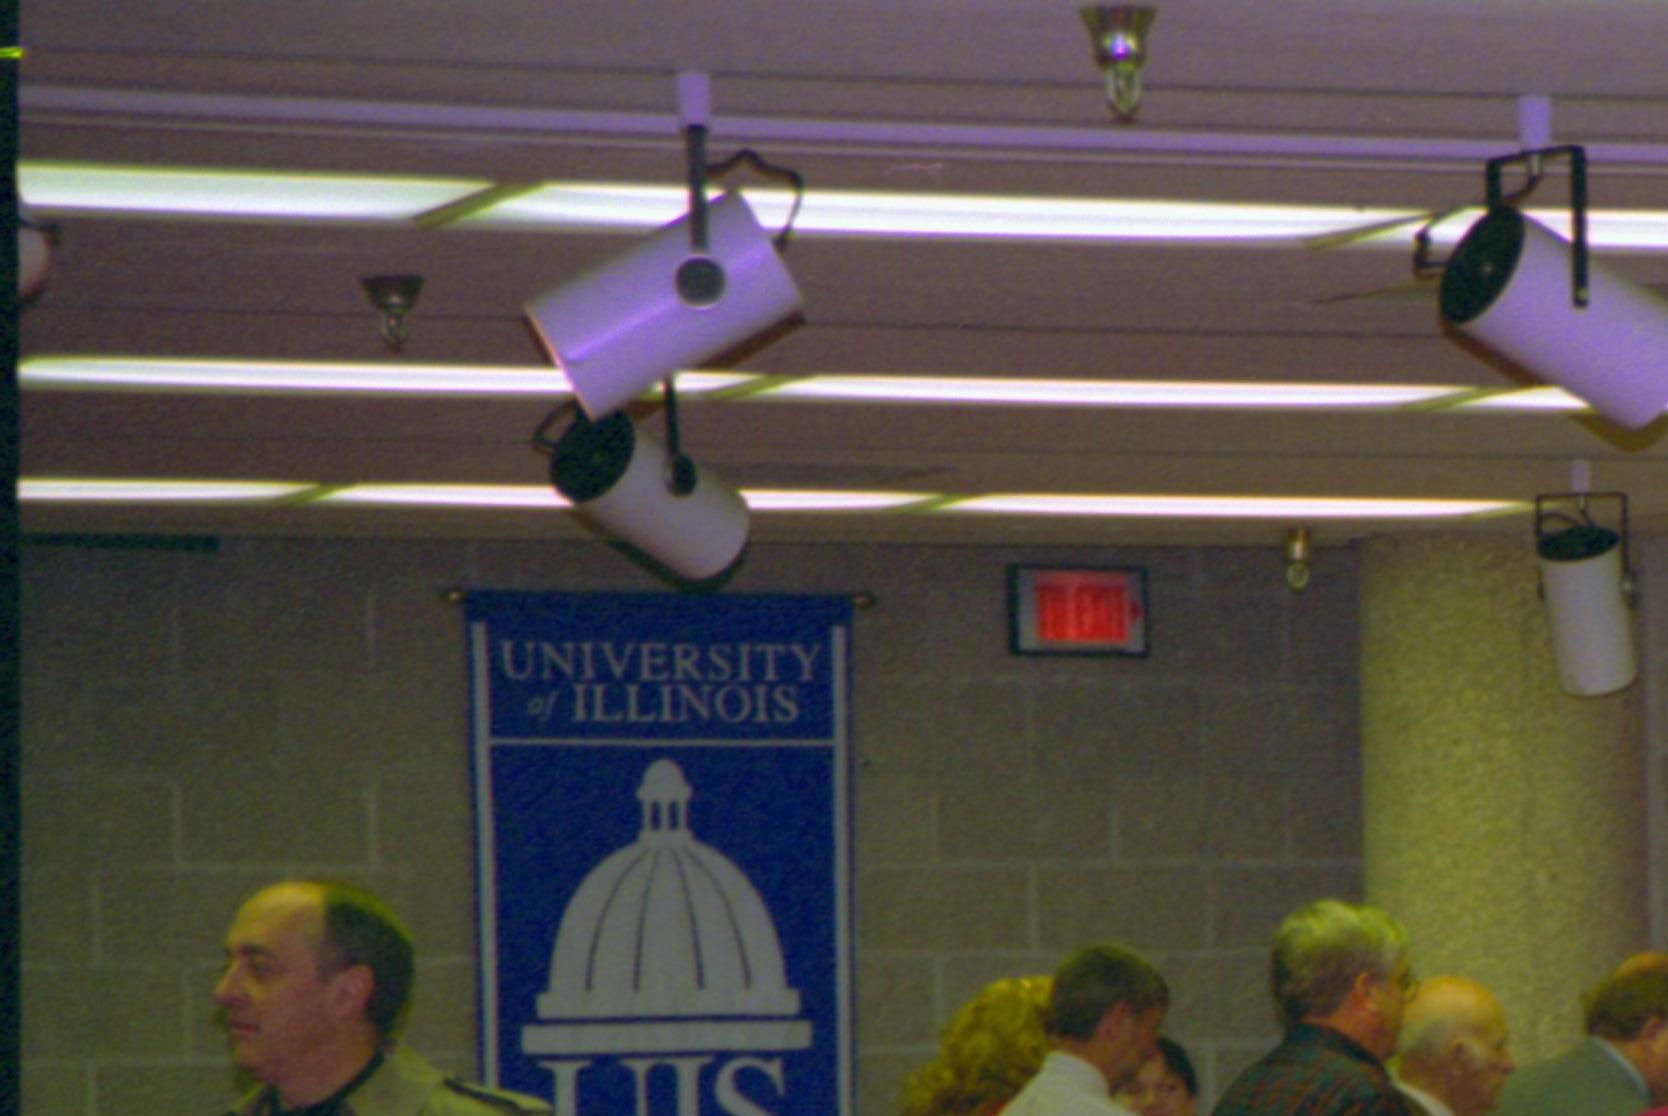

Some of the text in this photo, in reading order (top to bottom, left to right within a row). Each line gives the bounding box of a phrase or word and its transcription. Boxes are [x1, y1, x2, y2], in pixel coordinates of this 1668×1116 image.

[500, 640, 822, 683] UNIVERSITY
[526, 682, 801, 724] of ILLINOIS
